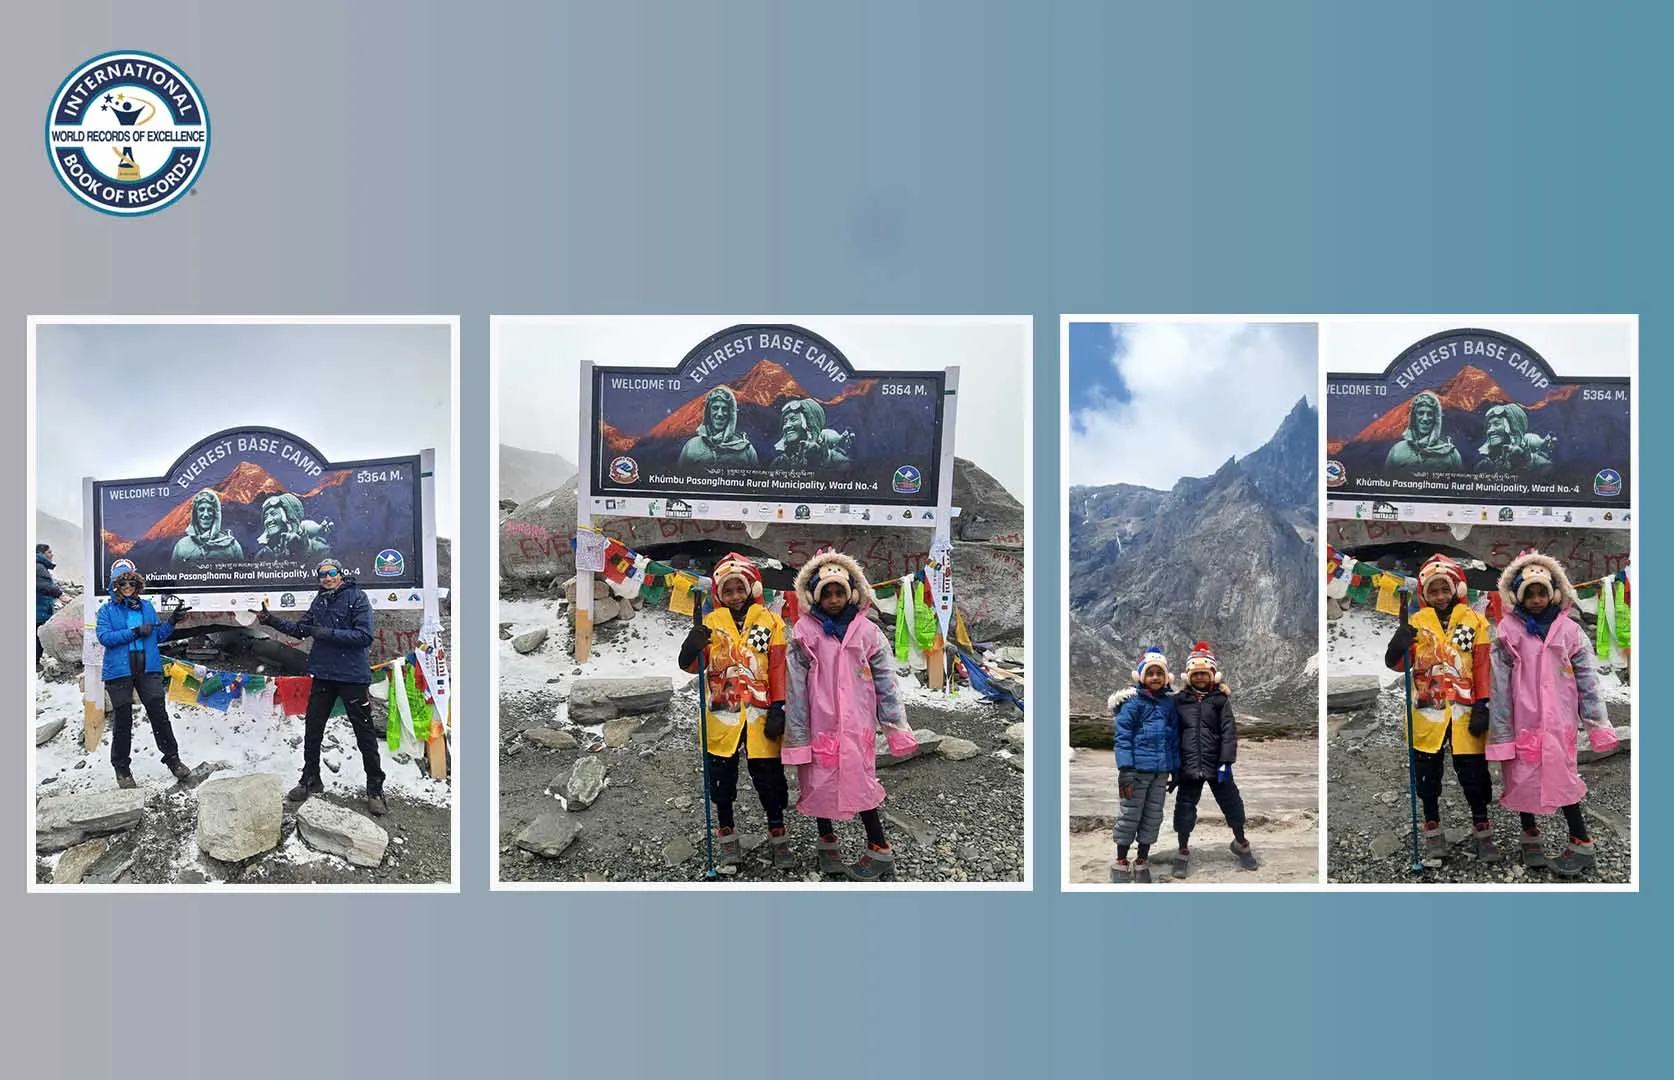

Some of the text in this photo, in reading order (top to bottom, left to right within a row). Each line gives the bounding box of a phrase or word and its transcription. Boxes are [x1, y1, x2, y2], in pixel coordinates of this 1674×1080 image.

[689, 334, 848, 384] EVEREST BASE CAMP
[1395, 341, 1549, 389] EVEREST BASE CAMP
[611, 378, 681, 390] WELCOME TO
[881, 384, 928, 396] 5364 M.
[1374, 385, 1387, 396] TO
[1583, 389, 1628, 401] 5364 M.
[177, 438, 322, 489] EVEREST BASE CAMP
[357, 470, 404, 484] 5364 M.
[686, 475, 745, 487] Pasanglhamu
[746, 478, 770, 488] Rural
[771, 479, 827, 491] Municipality,
[829, 480, 853, 490] Ward
[109, 486, 170, 500] WELCOME TO
[1392, 479, 1449, 490] Pasanglhamu
[1451, 481, 1474, 491] Rural
[1475, 482, 1530, 493] Municipality,
[1531, 483, 1555, 493] Ward
[179, 571, 232, 582] Pasanglhamu
[233, 571, 255, 580] Rural
[257, 569, 310, 580] Municipality,
[341, 567, 361, 576] o.-4
